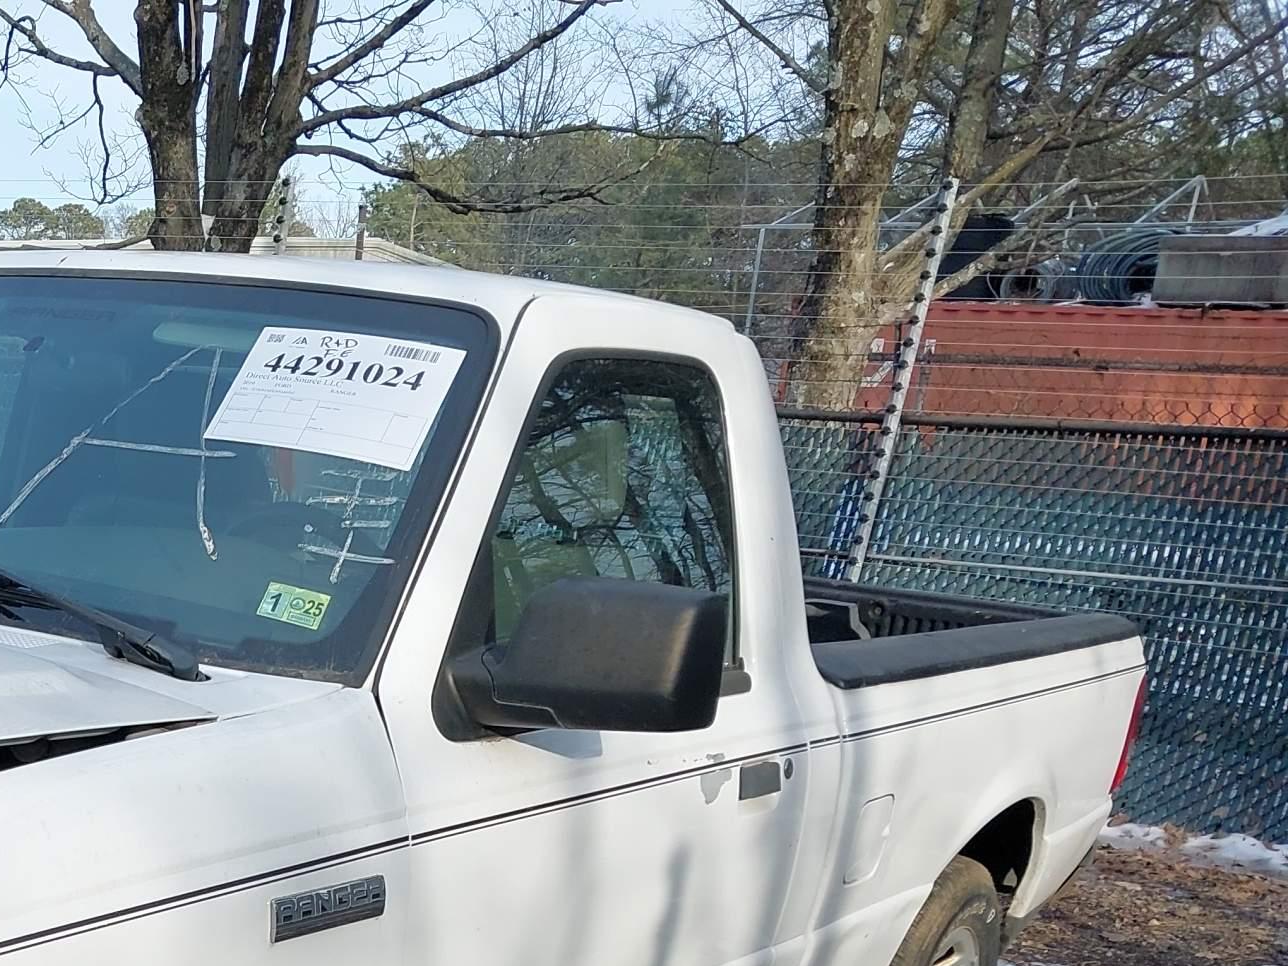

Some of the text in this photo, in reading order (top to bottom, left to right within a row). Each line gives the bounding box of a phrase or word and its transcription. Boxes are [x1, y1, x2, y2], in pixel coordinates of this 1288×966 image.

[245, 371, 344, 388] Direct Auto Source LLC
[263, 352, 426, 392] 44291024
[270, 592, 325, 617] 1 25
[273, 878, 383, 923] RANGER
